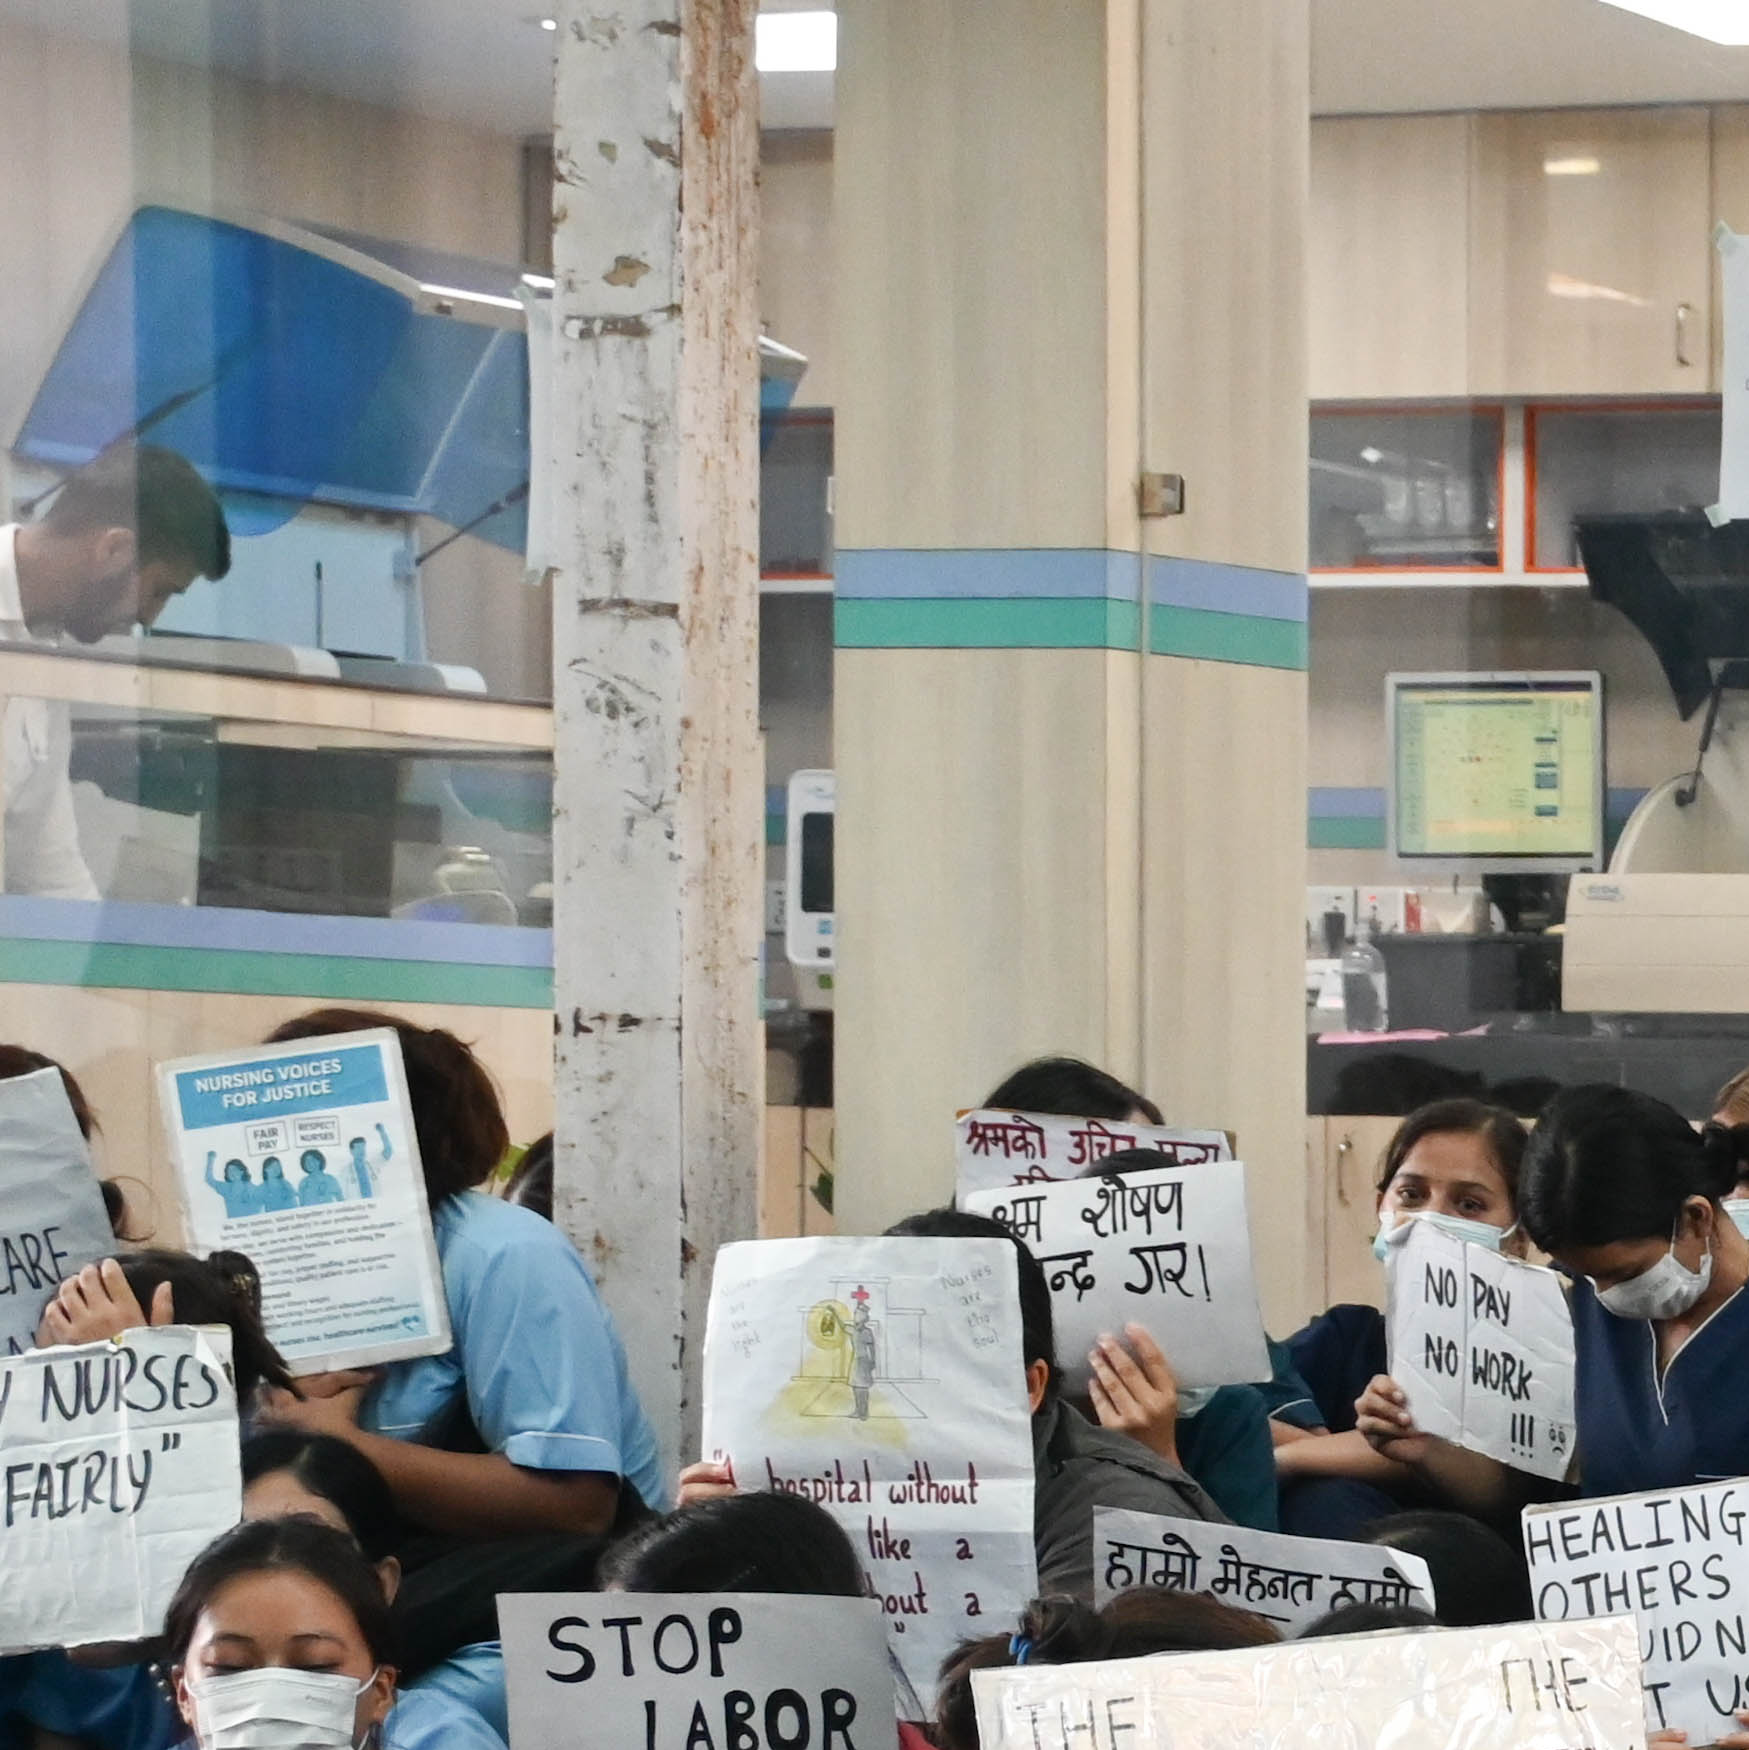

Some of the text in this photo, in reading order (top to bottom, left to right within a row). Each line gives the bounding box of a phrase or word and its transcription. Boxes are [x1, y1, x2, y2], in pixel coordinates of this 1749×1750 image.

[195, 1058, 343, 1095] NURSING VOICES
[222, 1080, 332, 1109] FOR JUSTICE
[253, 1127, 279, 1140] FAIR
[257, 1139, 278, 1152] PAY
[0, 1226, 68, 1294] ARE
[1425, 1261, 1511, 1327] NO PAY
[42, 1345, 219, 1425] NURSES
[1425, 1332, 1533, 1402] NO WORK
[888, 1460, 979, 1506] without
[867, 1515, 974, 1560] like a
[1526, 1491, 1747, 1566] HEALING
[965, 1591, 981, 1615] a
[1211, 1544, 1323, 1606] मेहनत
[1538, 1553, 1731, 1623] OTHERS
[546, 1607, 743, 1683] STOP
[1498, 1656, 1589, 1713] THE
